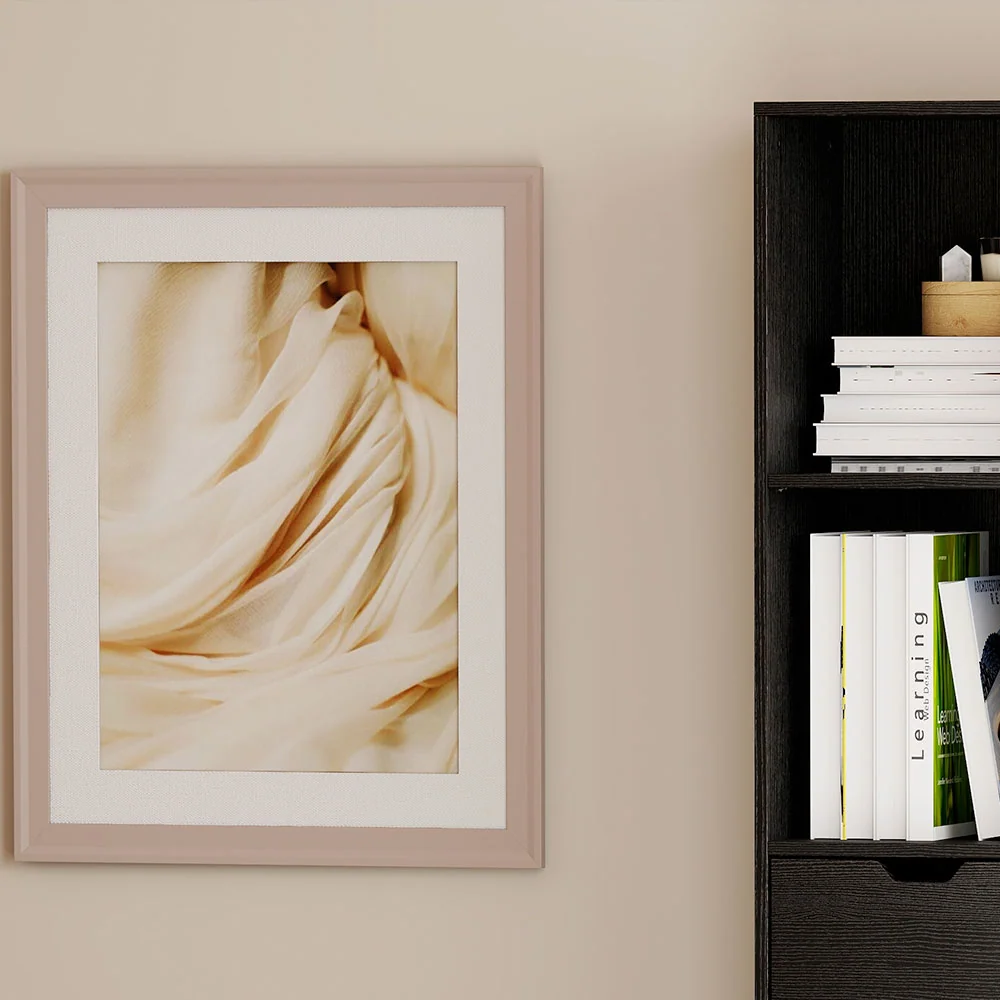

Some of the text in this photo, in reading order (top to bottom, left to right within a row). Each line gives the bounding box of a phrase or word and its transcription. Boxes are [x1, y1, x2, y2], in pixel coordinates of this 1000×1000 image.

[911, 612, 929, 761] Learning
[923, 658, 931, 721] Web Design
[936, 725, 963, 746] Web Des
